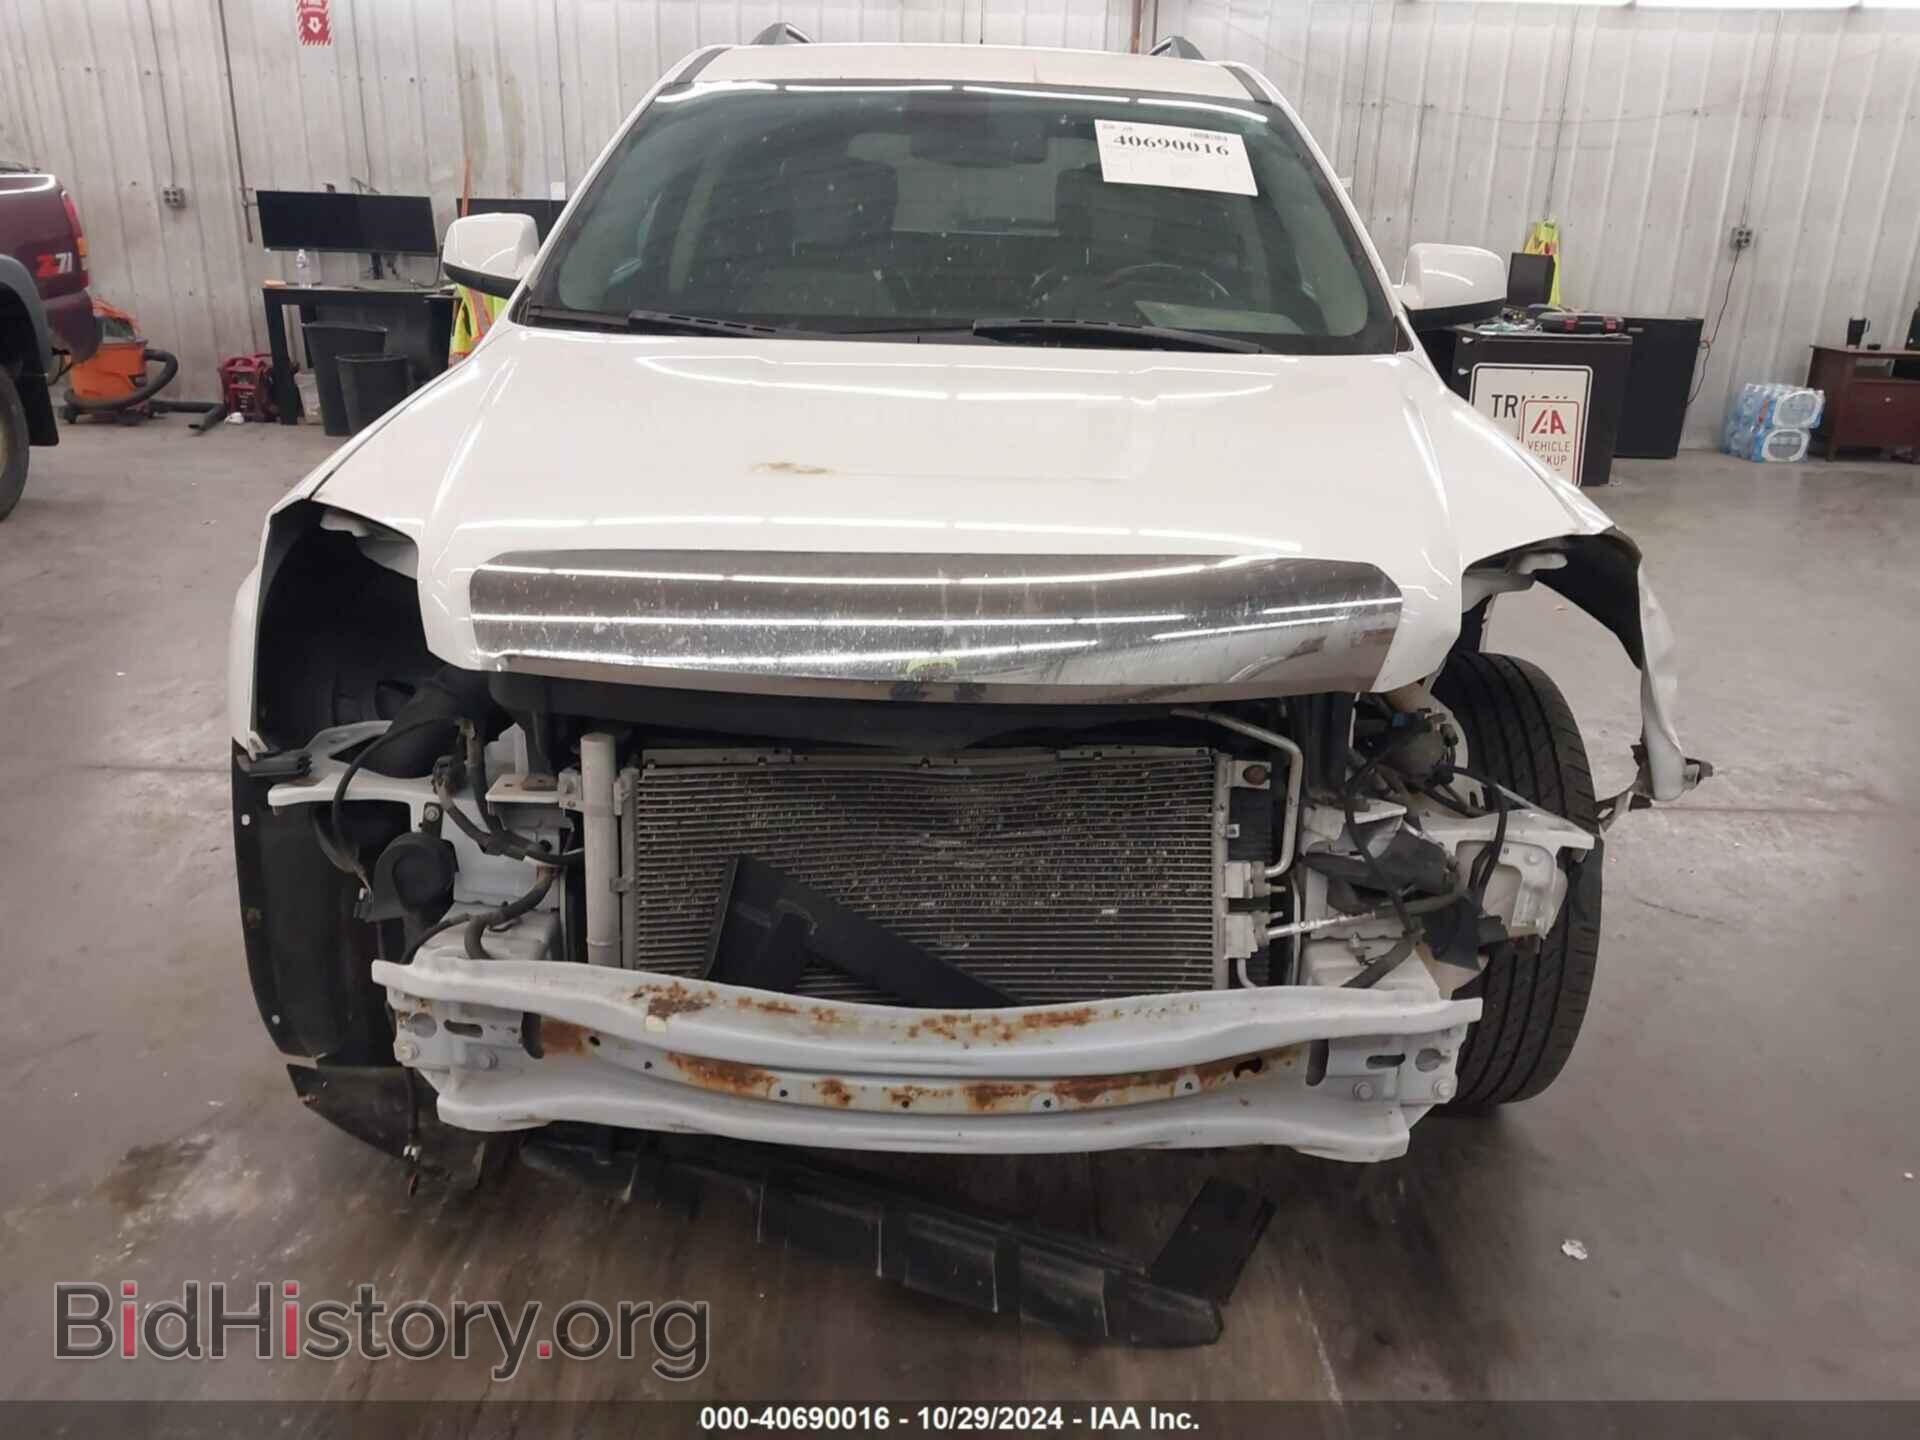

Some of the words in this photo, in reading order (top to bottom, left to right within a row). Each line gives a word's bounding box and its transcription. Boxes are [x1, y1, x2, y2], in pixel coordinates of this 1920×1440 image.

[1113, 134, 1229, 156] 40690016
[37, 252, 73, 277] Z71
[1527, 440, 1571, 452] VEHICLE
